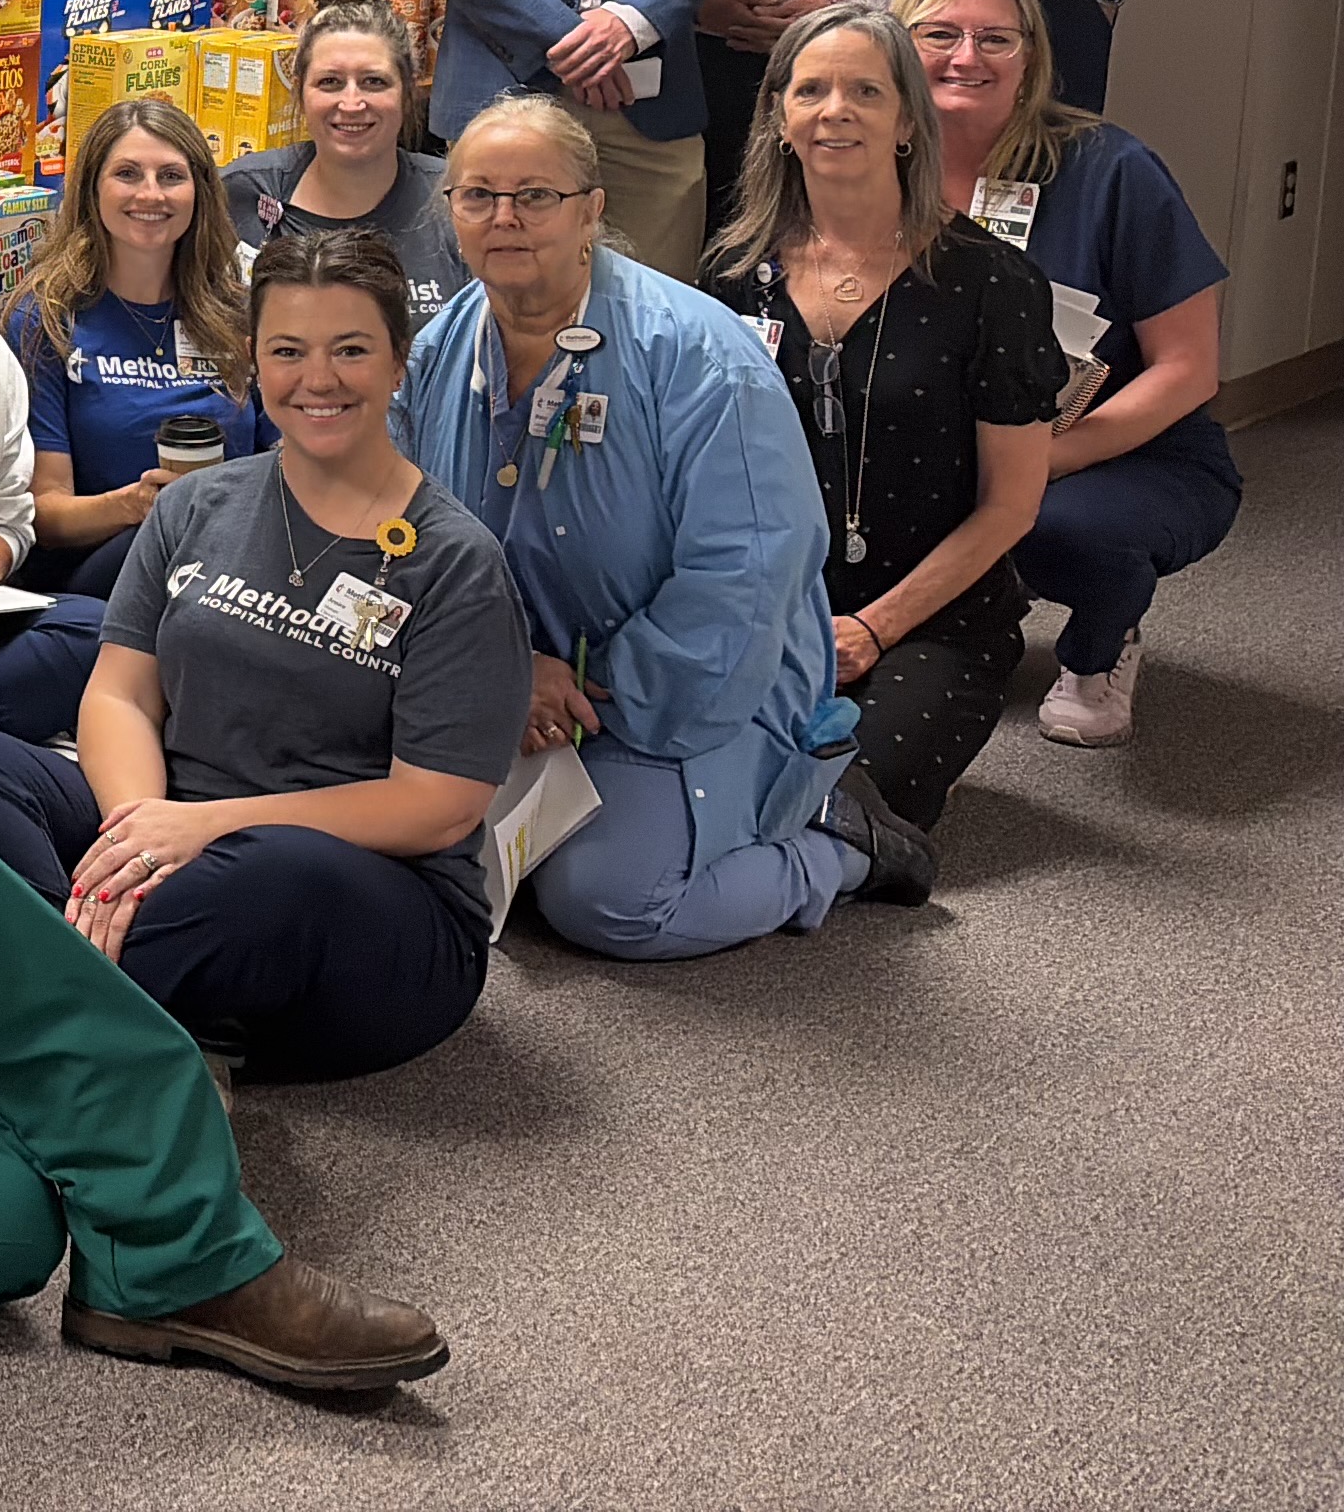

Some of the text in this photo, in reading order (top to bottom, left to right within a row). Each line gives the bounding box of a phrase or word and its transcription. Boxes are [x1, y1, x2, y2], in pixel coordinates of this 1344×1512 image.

[66, 4, 110, 28] FLAKES
[152, 0, 192, 20] FLAKES
[73, 44, 114, 56] CEREAL
[72, 53, 116, 67] DE MAIZ
[140, 59, 168, 71] CORN
[126, 67, 181, 92] FLAKES
[988, 220, 1012, 234] RN
[97, 356, 178, 380] Metho
[197, 360, 219, 372] RN
[102, 376, 163, 388] HOSPITAL
[207, 574, 362, 648] Methodis
[198, 594, 402, 678] HOSPITAL HILL COUNTR
